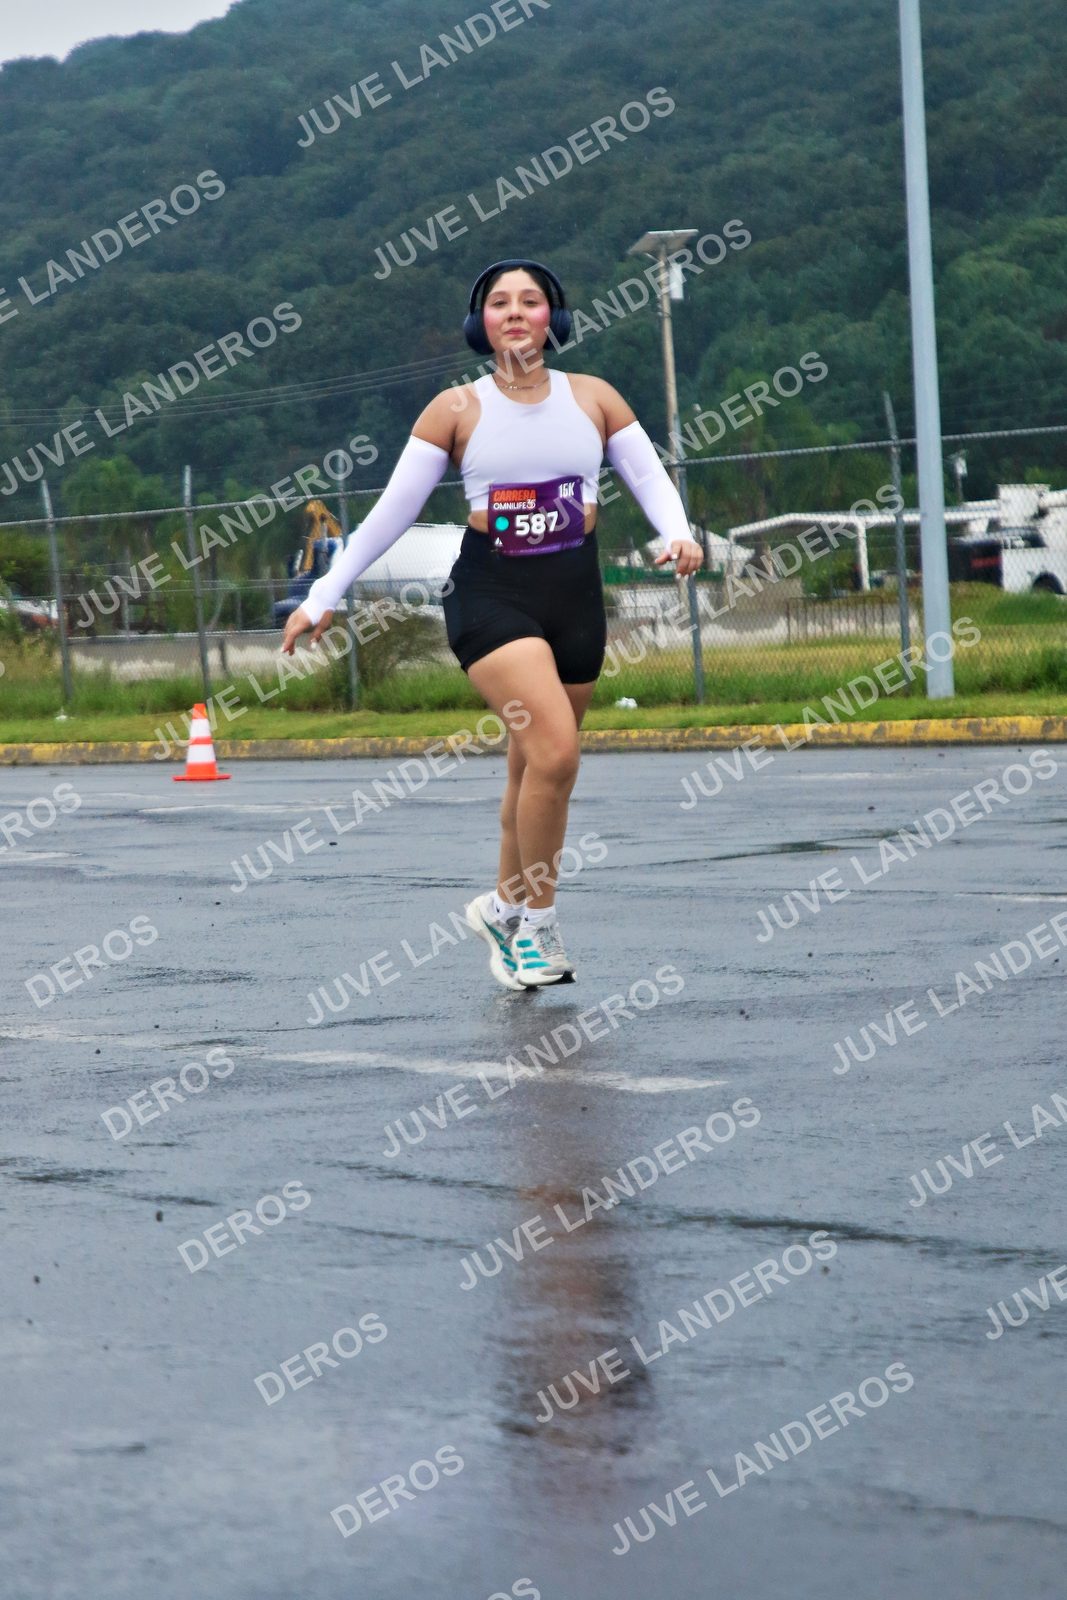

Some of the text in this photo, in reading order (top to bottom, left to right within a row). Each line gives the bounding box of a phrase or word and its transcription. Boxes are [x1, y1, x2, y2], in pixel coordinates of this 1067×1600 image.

[493, 490, 536, 502] CARRERA
[558, 482, 575, 498] 15K
[493, 502, 526, 511] OMNILIFE
[515, 510, 558, 536] 587
